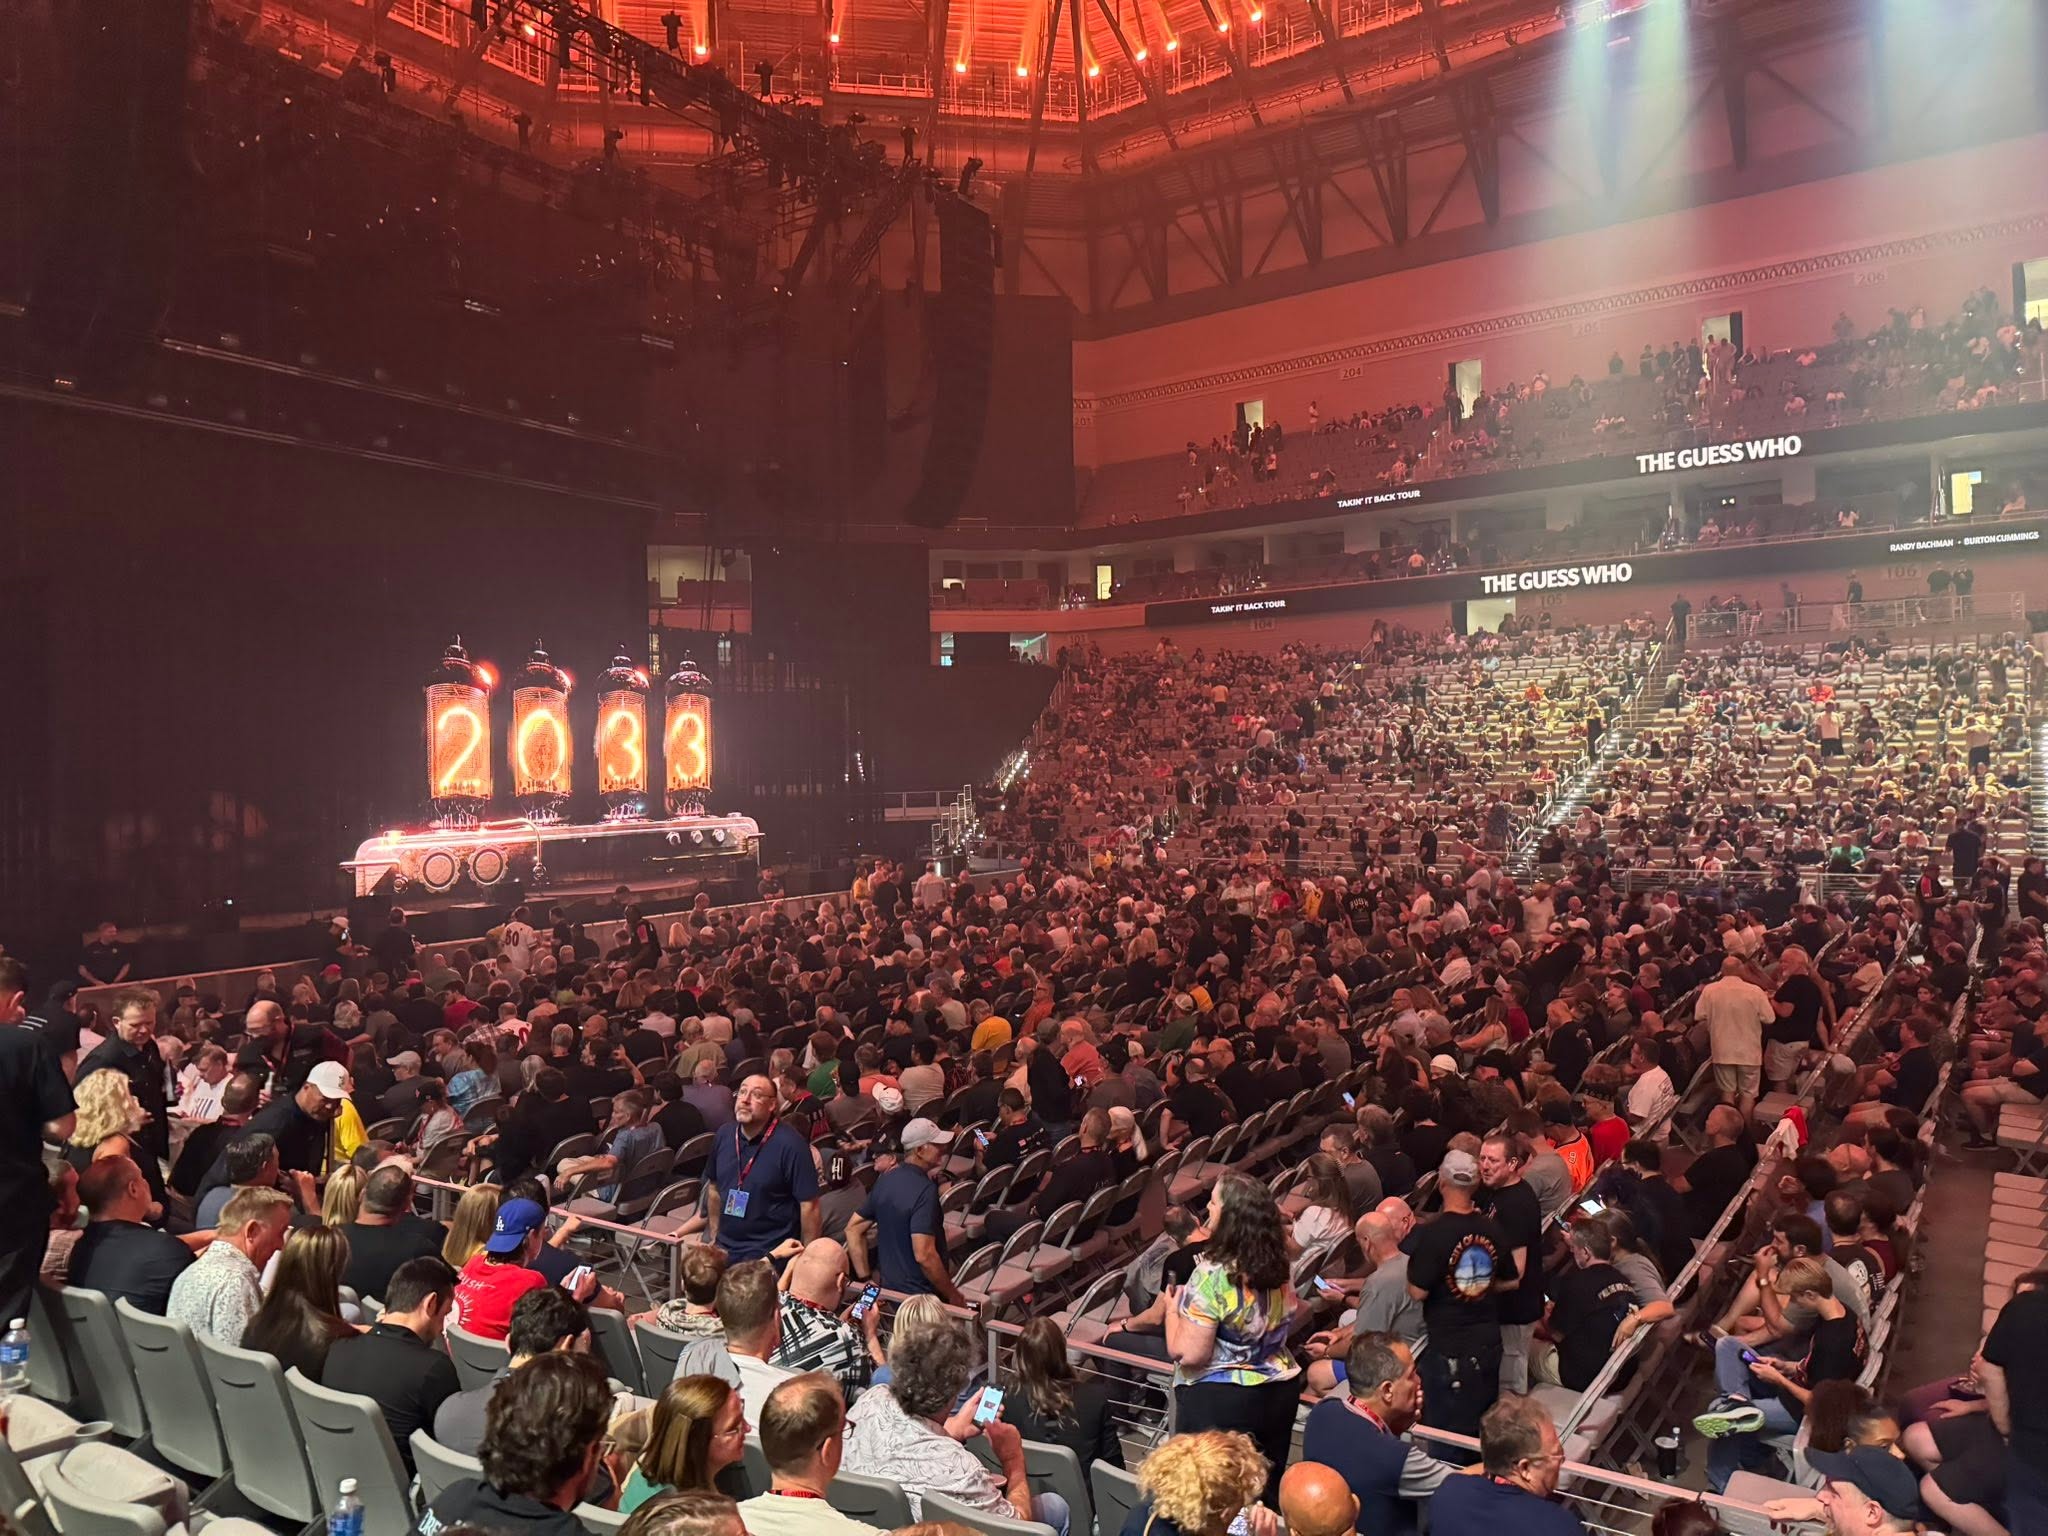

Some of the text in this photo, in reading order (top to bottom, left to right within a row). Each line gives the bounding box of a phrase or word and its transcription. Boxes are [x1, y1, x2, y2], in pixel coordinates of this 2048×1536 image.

[1636, 435, 1802, 474] THE GUESS WHO
[1364, 496, 1373, 504] IT
[1374, 494, 1396, 503] BACK
[1397, 490, 1421, 499] TOUR
[1890, 531, 2040, 552] RANDY BACHMAN BURTON CUMMINGS
[1481, 562, 1633, 594] THE GUESS WHO
[1235, 603, 1243, 611] IT
[1243, 601, 1264, 610] BACK
[1264, 600, 1286, 608] TOUR
